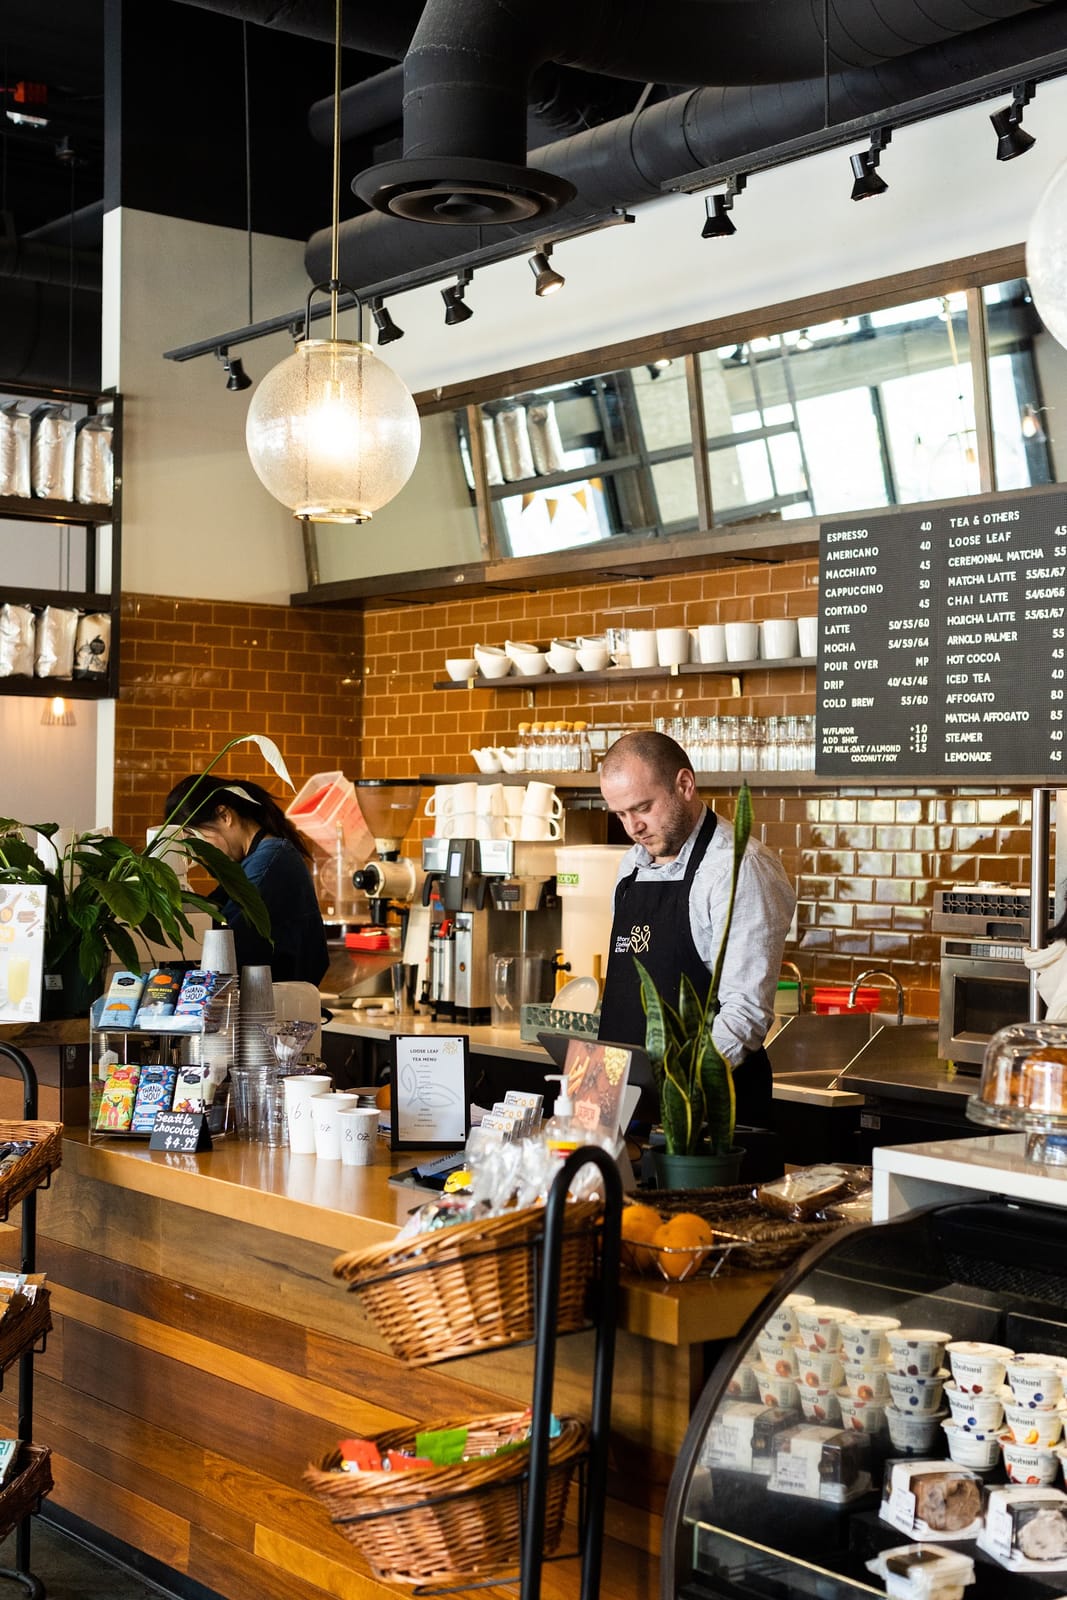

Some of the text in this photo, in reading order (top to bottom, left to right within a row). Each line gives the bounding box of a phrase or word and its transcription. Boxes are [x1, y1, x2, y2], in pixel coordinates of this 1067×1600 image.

[950, 511, 1019, 528] TEA & OTHERS
[827, 529, 868, 542] ESPRESSO
[949, 535, 980, 547] LOOSE
[986, 532, 1011, 543] LEAF
[827, 547, 879, 560] AMERICANO
[948, 553, 1003, 567] CEREMONIAL
[1007, 548, 1044, 561] MATCHA
[826, 566, 877, 579] MACCHIATO
[948, 574, 985, 586] MATCHA
[988, 571, 1016, 583] LATTE
[825, 584, 883, 597] CAPPUCCINO
[947, 595, 973, 606] CHAI
[980, 592, 1008, 603] LATTE
[825, 604, 867, 616] CORTADO
[947, 614, 984, 625] HOJICHA
[987, 612, 1015, 623] LATTE
[825, 624, 850, 634] LATTE
[947, 634, 982, 645] ARNOLD
[984, 631, 1017, 642] PALMER
[824, 642, 856, 653] MOCHA
[824, 657, 929, 671] POUR OVER MP
[947, 655, 965, 664] HOT
[966, 653, 1000, 663] COCOA
[824, 680, 844, 689] DRIP
[947, 674, 968, 684] ICED
[973, 673, 991, 683] TEA
[823, 699, 846, 708] COLD
[852, 698, 874, 707] BREW
[946, 693, 995, 704] AFFOGATO
[945, 713, 980, 723] MATCHA
[983, 711, 1029, 722] AFFOGATO
[842, 736, 858, 744] SHOT
[945, 732, 982, 742] STEAMER
[945, 752, 991, 762] LEMONADE
[156, 1112, 194, 1124] Seattle
[164, 1135, 197, 1150] $4.99
